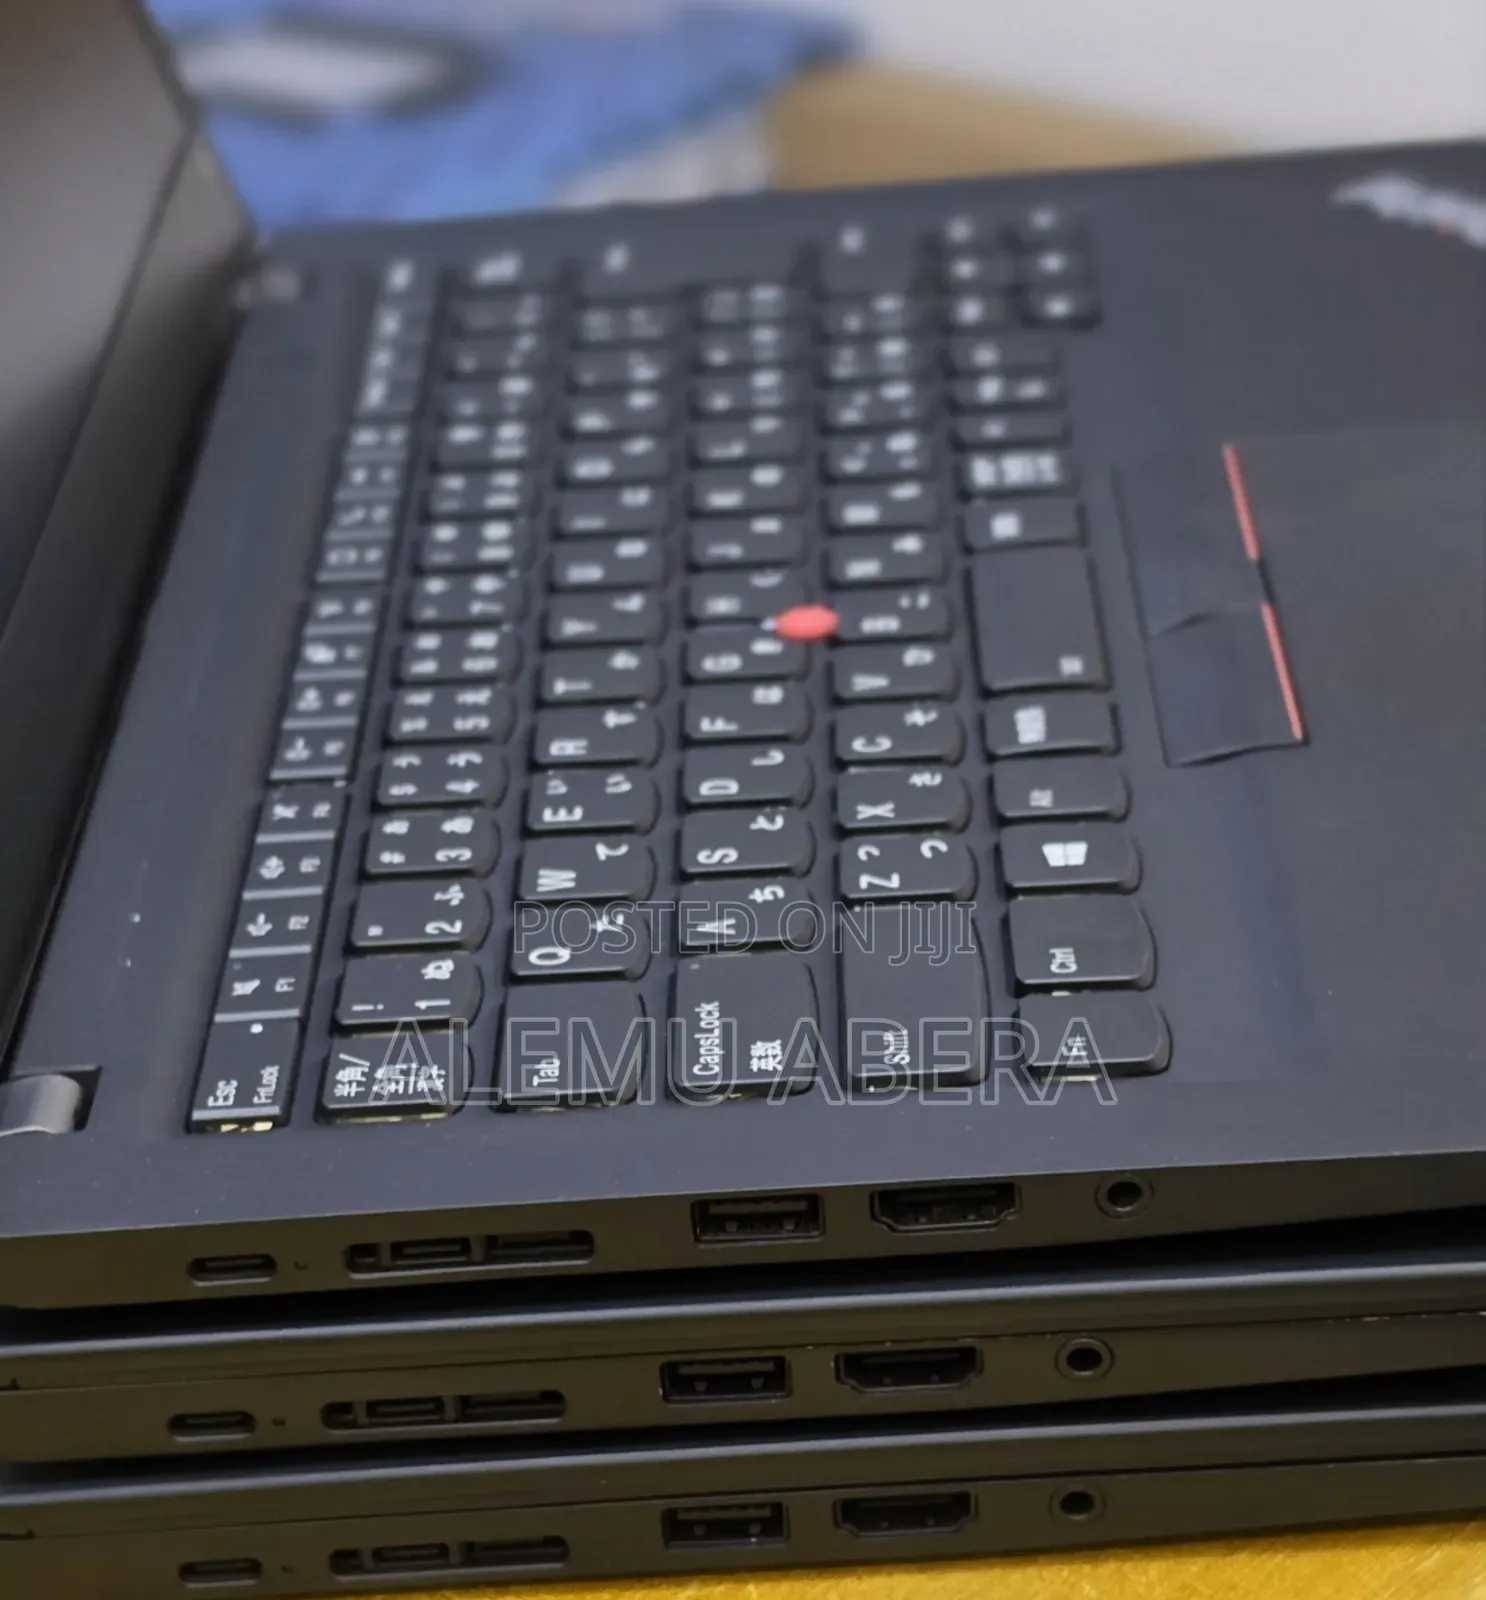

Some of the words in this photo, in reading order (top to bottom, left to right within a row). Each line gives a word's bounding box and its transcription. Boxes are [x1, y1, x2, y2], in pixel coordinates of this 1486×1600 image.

[554, 679, 590, 694] T
[700, 718, 737, 732] F
[852, 737, 892, 752] C
[752, 750, 784, 765] し
[446, 780, 478, 793] 4
[700, 780, 739, 795] D
[543, 806, 583, 822] E
[857, 803, 894, 819] X
[435, 848, 472, 861] 3
[596, 843, 628, 860] て
[697, 848, 738, 864] S
[920, 840, 948, 858] つ
[537, 869, 576, 892] W
[859, 873, 900, 889] Z
[749, 886, 784, 903] ち
[425, 920, 462, 934] 2
[696, 917, 736, 936] A
[275, 978, 295, 992] F1
[415, 1000, 450, 1009] 1
[693, 1001, 720, 1075] CapsLock
[532, 1058, 560, 1087] Tab
[208, 1080, 237, 1107] Esc
